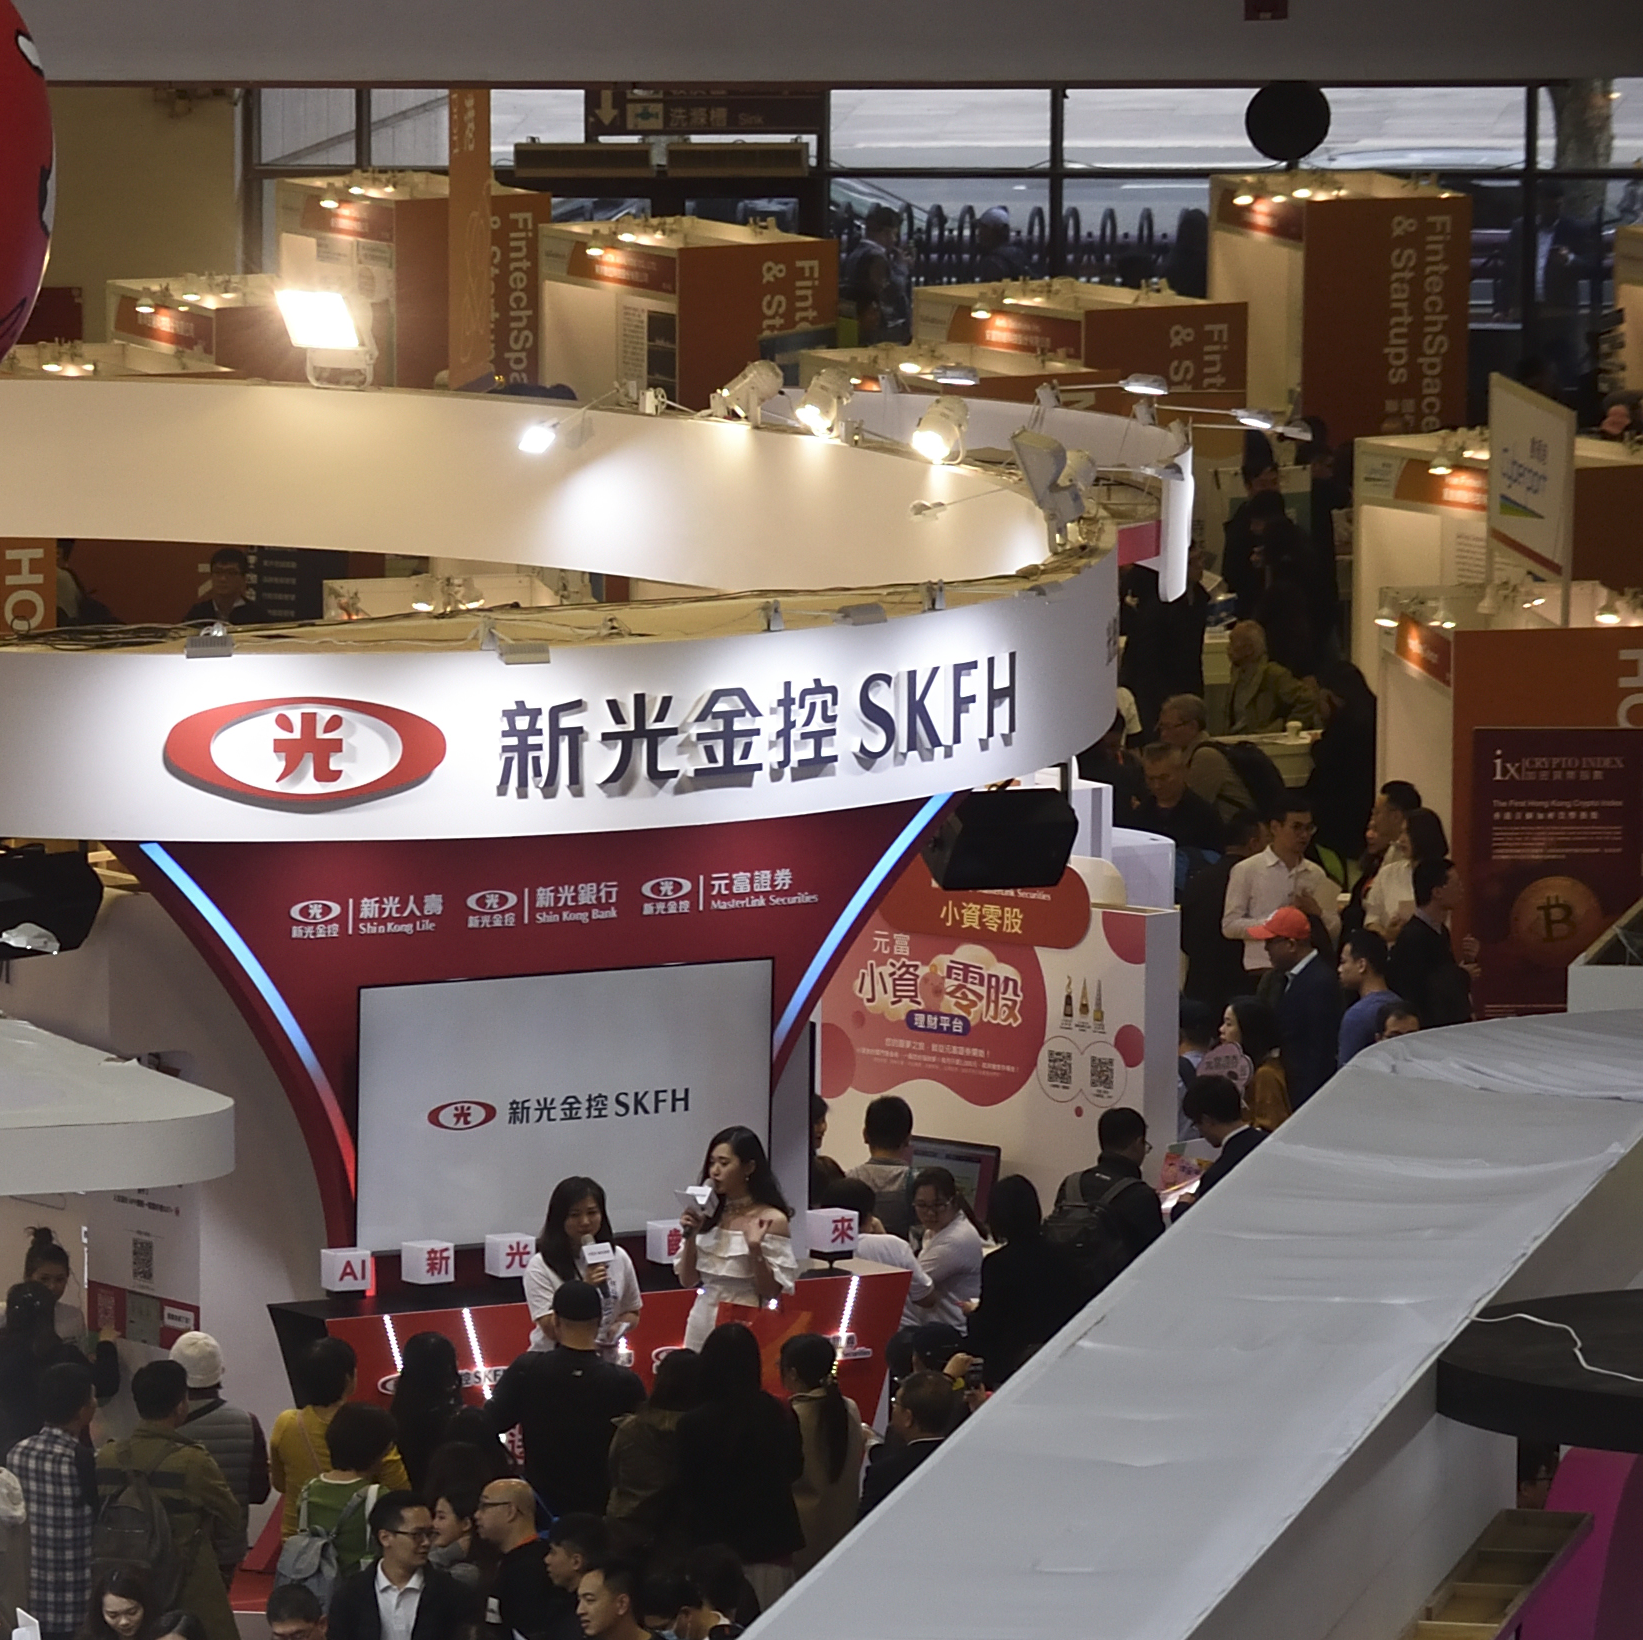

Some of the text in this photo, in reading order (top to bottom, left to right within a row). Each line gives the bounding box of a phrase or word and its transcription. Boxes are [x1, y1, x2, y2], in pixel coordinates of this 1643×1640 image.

[1382, 248, 1416, 386] Startups
[495, 650, 1018, 799] 新光金控 SKFH
[1581, 756, 1625, 769] INDEX
[535, 882, 618, 908] 新光銀行
[710, 868, 794, 895] 元富證券
[358, 894, 444, 920] 新光人壽
[768, 892, 820, 907] Securities
[591, 907, 618, 920] Bank
[939, 899, 1024, 935] 小資零股
[872, 929, 911, 957] 元富
[913, 1013, 964, 1034] 理財平台
[506, 1086, 691, 1126] 新光金控 SKFH
[338, 1215, 855, 1282] AI 新 光 來
